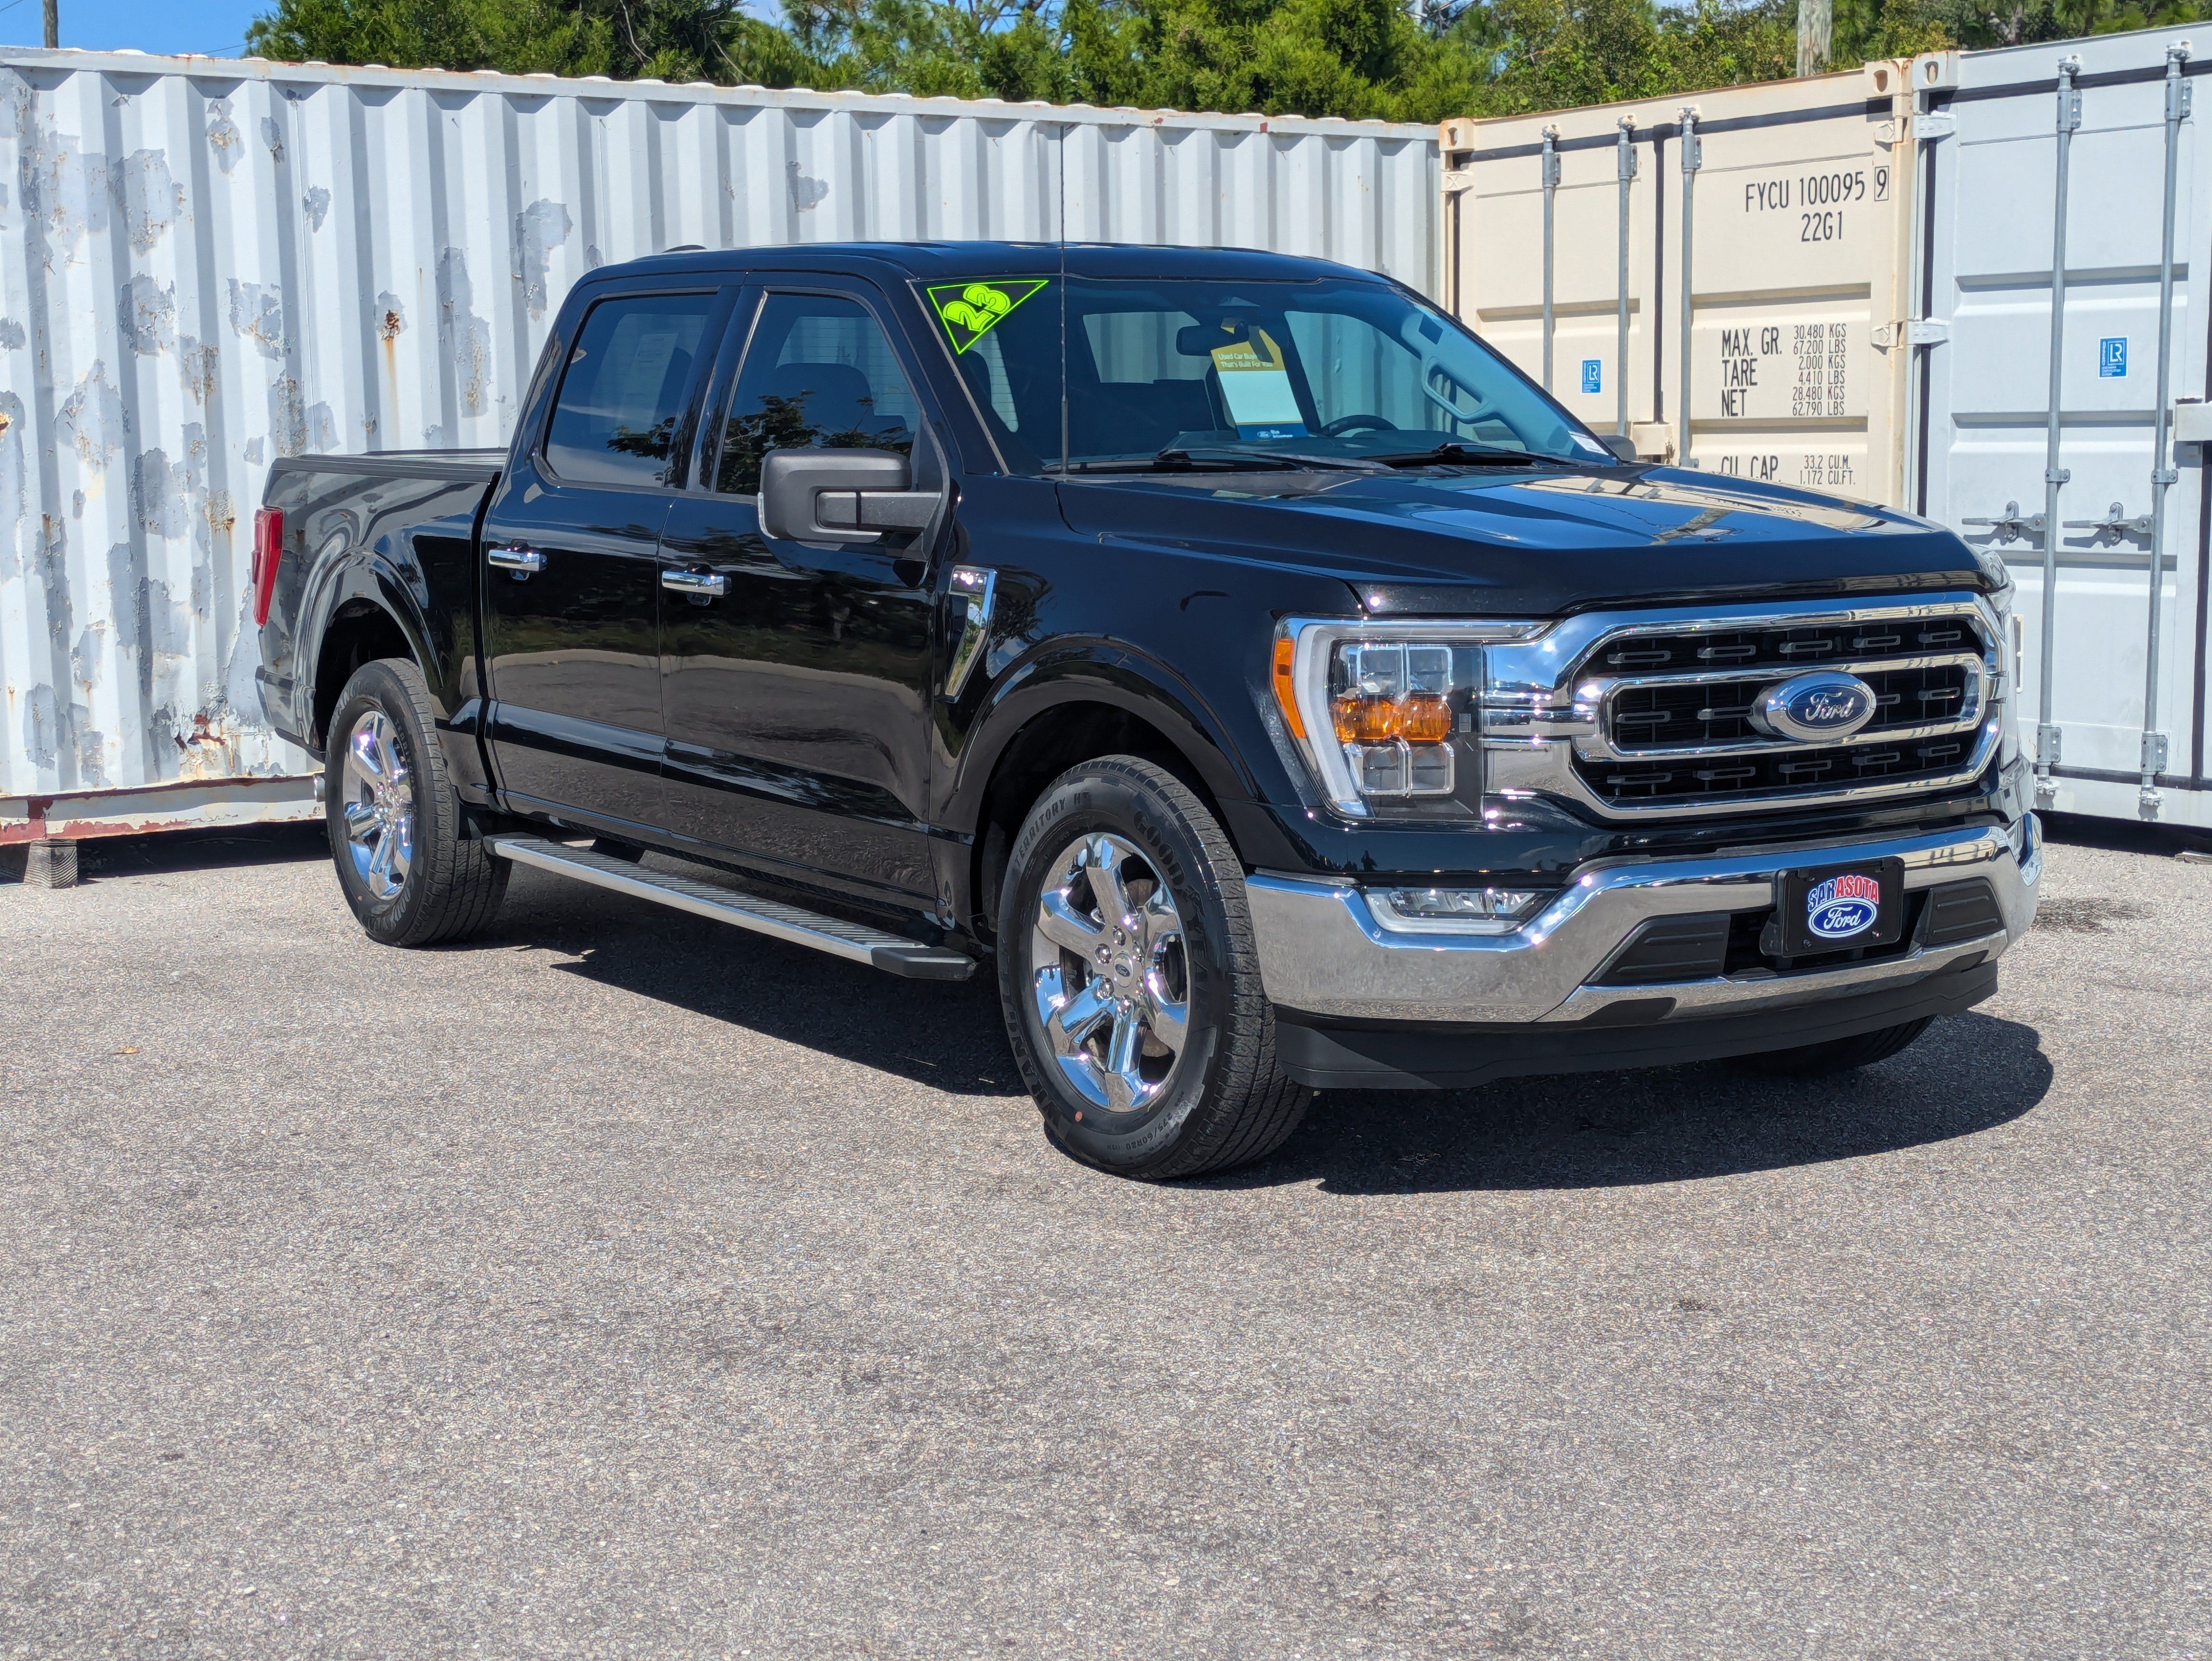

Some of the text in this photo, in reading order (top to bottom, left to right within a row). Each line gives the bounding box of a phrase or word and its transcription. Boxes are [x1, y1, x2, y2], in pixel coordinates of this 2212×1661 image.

[1745, 168, 1888, 213] FYCU 100095 9
[1801, 210, 1844, 243] 22G1
[943, 285, 1010, 332] 23
[1722, 327, 1782, 357] MAX. GR.
[1829, 323, 1847, 338] KGS
[1829, 339, 1846, 354] LBS
[1722, 358, 1758, 387] TARE
[1828, 354, 1846, 369] KGS
[1828, 370, 1845, 385] LBS
[1722, 388, 1747, 417] NET
[1828, 386, 1845, 400] KGS
[1828, 401, 1845, 416] LBS
[1804, 454, 1851, 469] 33.2 CU.M.
[1828, 470, 1856, 485] CU.FT.
[1805, 692, 1854, 721] Ford
[1808, 875, 1880, 912] SARASOTA
[1823, 906, 1863, 930] Ford
